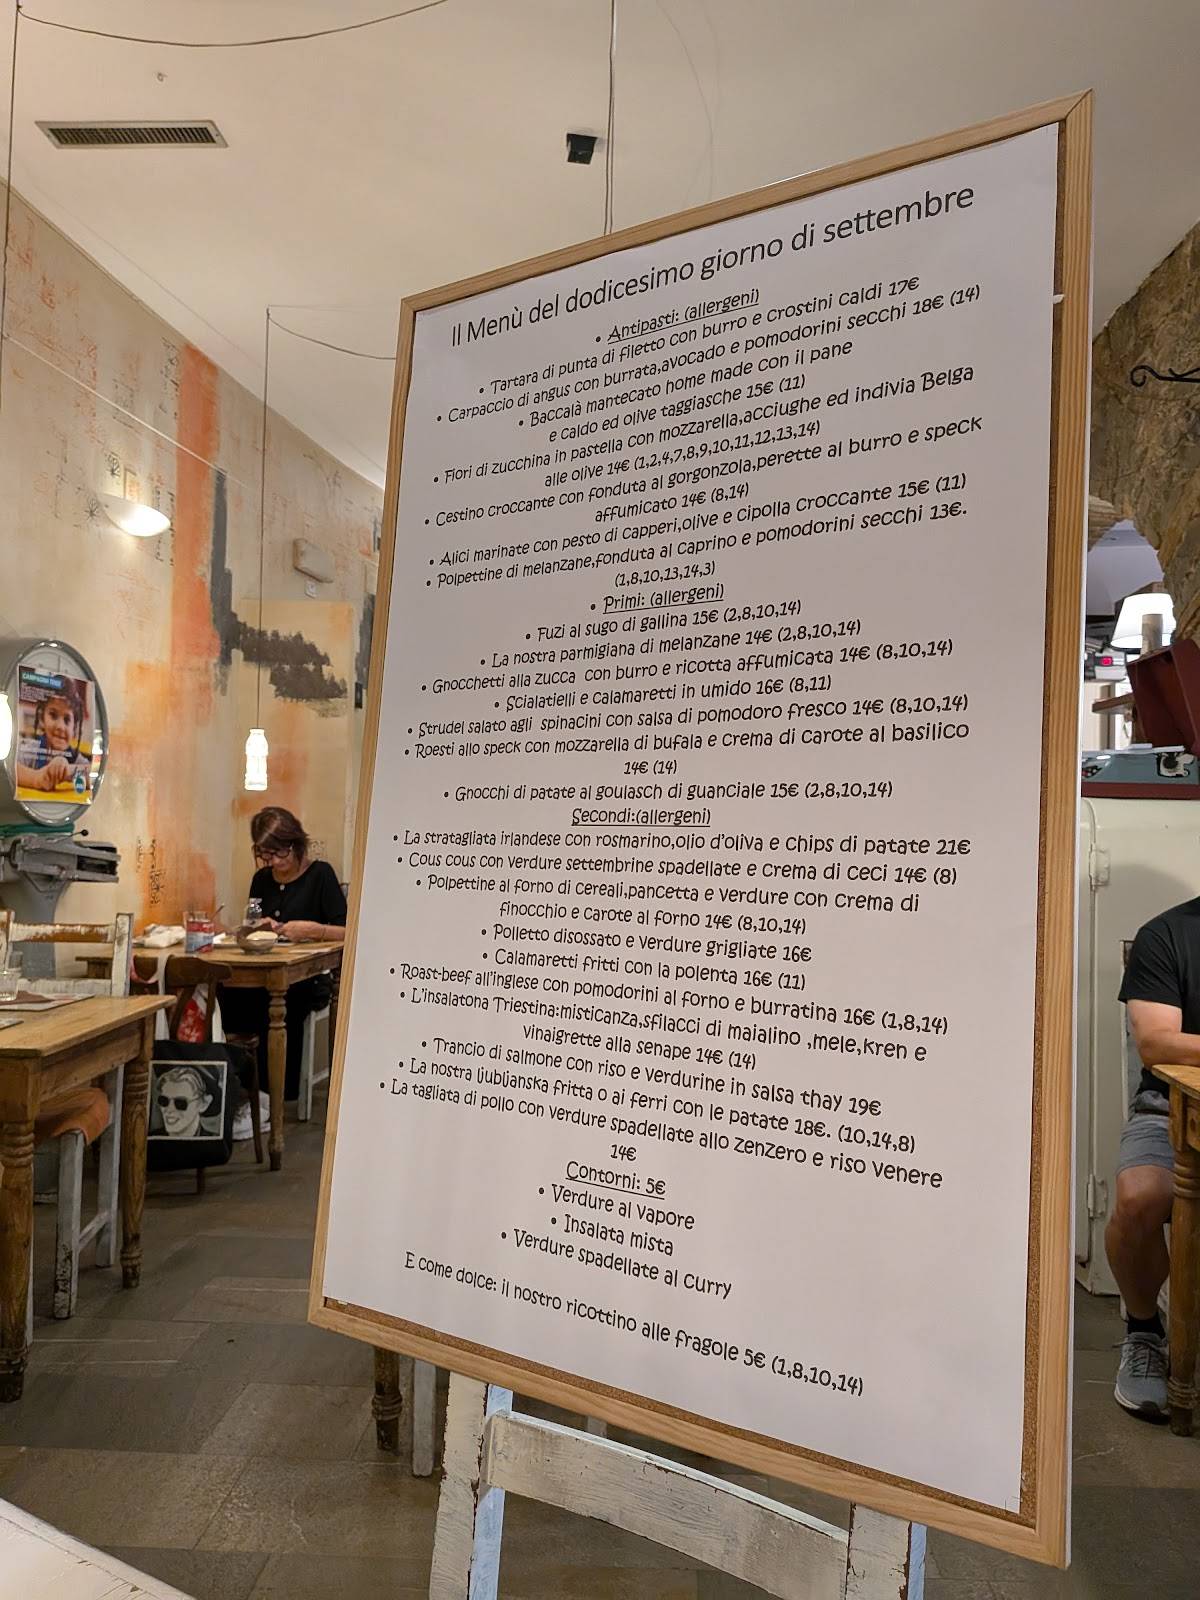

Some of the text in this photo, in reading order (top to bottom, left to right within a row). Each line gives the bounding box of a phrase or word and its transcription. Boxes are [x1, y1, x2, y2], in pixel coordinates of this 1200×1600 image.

[451, 187, 975, 348] Il Menù del dodicesimo giorno di settembre
[489, 276, 920, 395] Tartara di punta di filetto con burro e crostini caldi 17€
[606, 287, 760, 344] Antipasti: (allergeni)
[528, 340, 853, 428] Baccalà mantecato home made con il pane
[594, 481, 750, 523] affumicato 14€ (8,14)
[614, 559, 716, 589] (1,8,10,13,14,3)
[602, 582, 725, 614] Primi: (allergeni)
[536, 598, 802, 643] Fuzi al sugo di gallina 15€ (2,8,10,14)
[491, 618, 862, 669] La nostra parmigiana di melanzane 14€ (2,8,10,14)
[431, 638, 954, 695] Gnocchetti alla zucca con burro e ricotta affumicata 14€ (8,10,14)
[505, 673, 832, 713] Scialatielli e calamaretti in umido 16€ (8,11)
[623, 759, 678, 776] 14€ (14)
[454, 780, 894, 802] Gnocchi di patate al goulasch di guanciale 15€ (2,8,10,14)
[571, 806, 712, 827] Secondi:(allergeni)
[408, 851, 958, 886] Cous cous con verdure settembrine spadellate e crema di ceci 14€ (8)
[498, 900, 807, 936] finocchio e carote al forno 14€ (8,10,14)
[492, 923, 813, 963] Polletto disossato e verdure grigliate 16€
[494, 947, 806, 992] Calamaretti fritti con la polenta 16€ (11)
[522, 1023, 757, 1072] vinaigrette alla senape 14€ (14)
[432, 1036, 882, 1117] Trancio di salmone con riso e verdurine in salsa thay 19€
[609, 1143, 638, 1163] 14€
[565, 1160, 667, 1197] Contorni: 5€
[550, 1182, 696, 1231] Verdure al vapore
[563, 1213, 674, 1257] Insalata mista
[512, 1227, 733, 1301] Verdure spadellate al curry
[403, 1250, 864, 1398] E come dolce: il nostro ricottino alle fragole 5€ (1,8,10,14)
